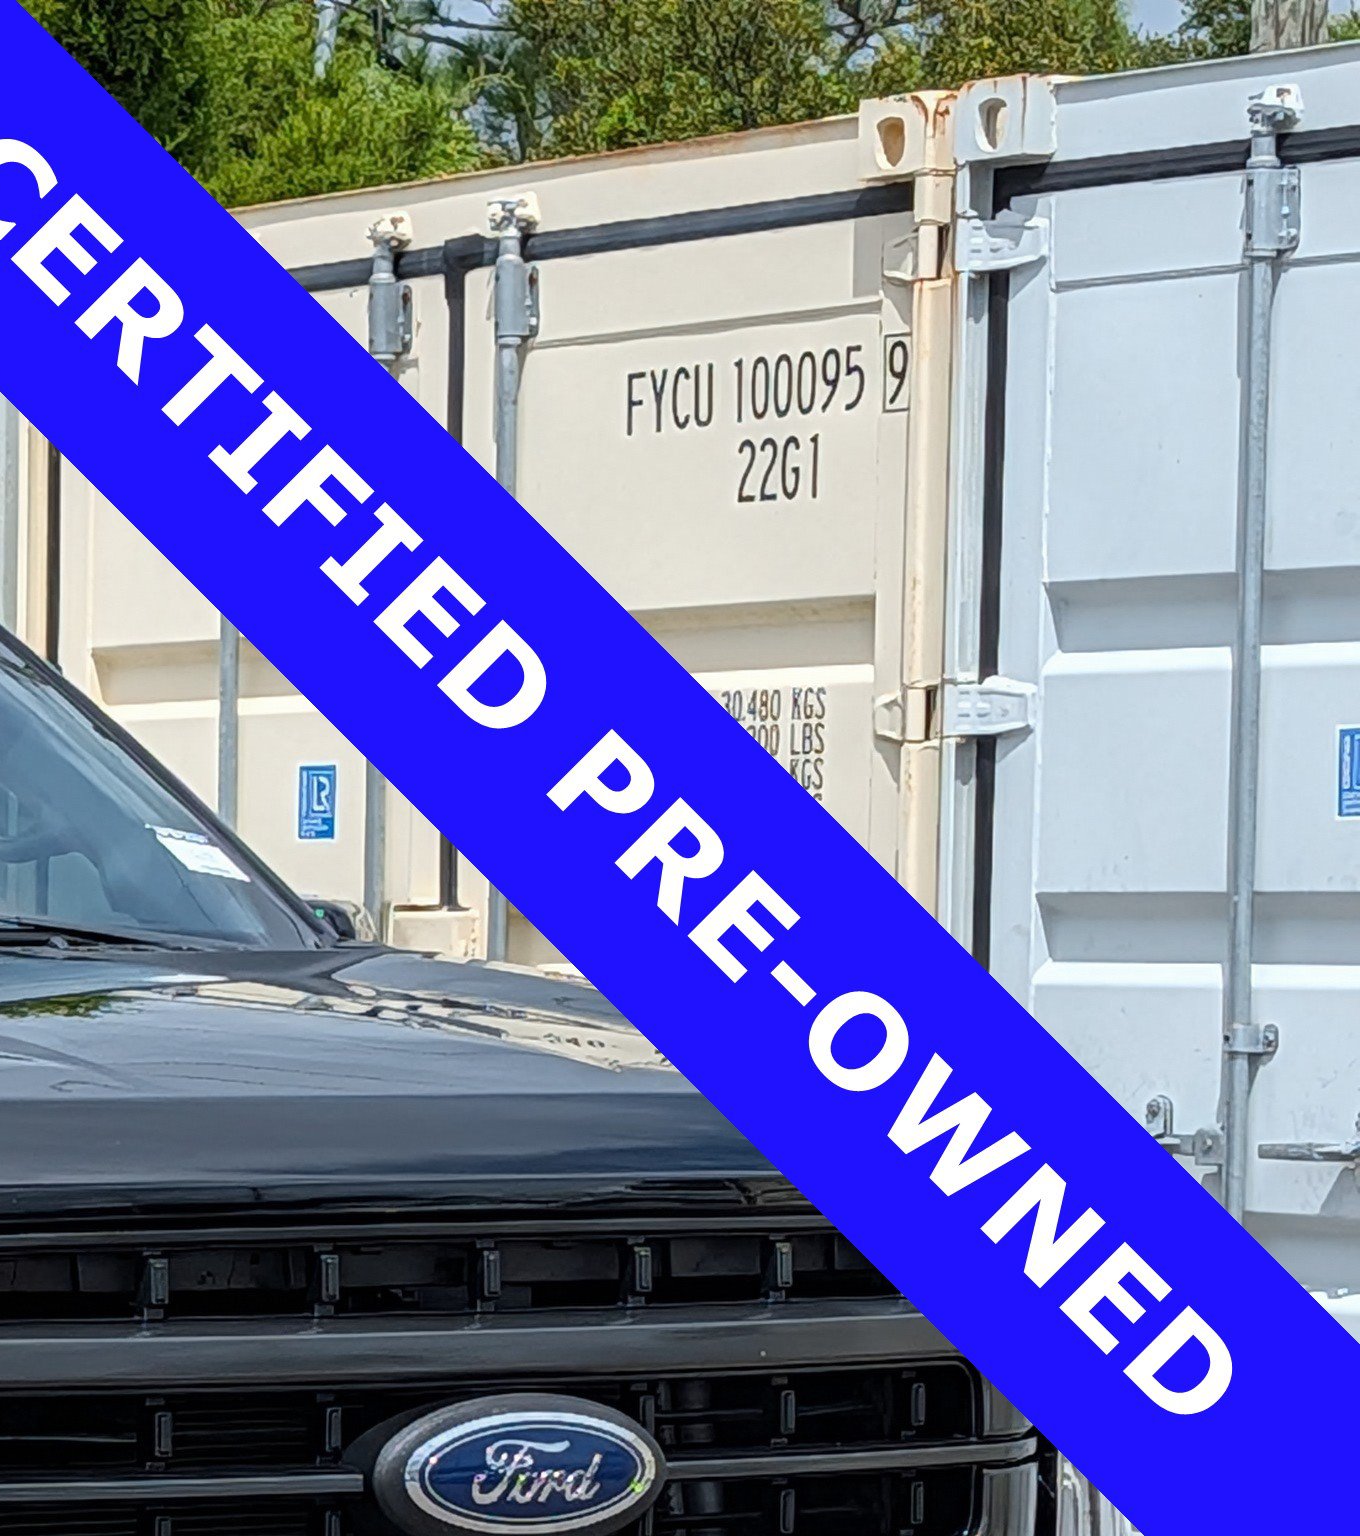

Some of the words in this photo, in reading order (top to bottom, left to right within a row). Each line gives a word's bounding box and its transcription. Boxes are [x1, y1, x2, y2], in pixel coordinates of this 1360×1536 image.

[626, 362, 714, 436] FYCU
[733, 344, 866, 423] 100095
[737, 433, 820, 503] 22G1
[791, 687, 827, 720] KGS
[790, 722, 826, 756] LBS
[471, 1439, 603, 1505] Ford
